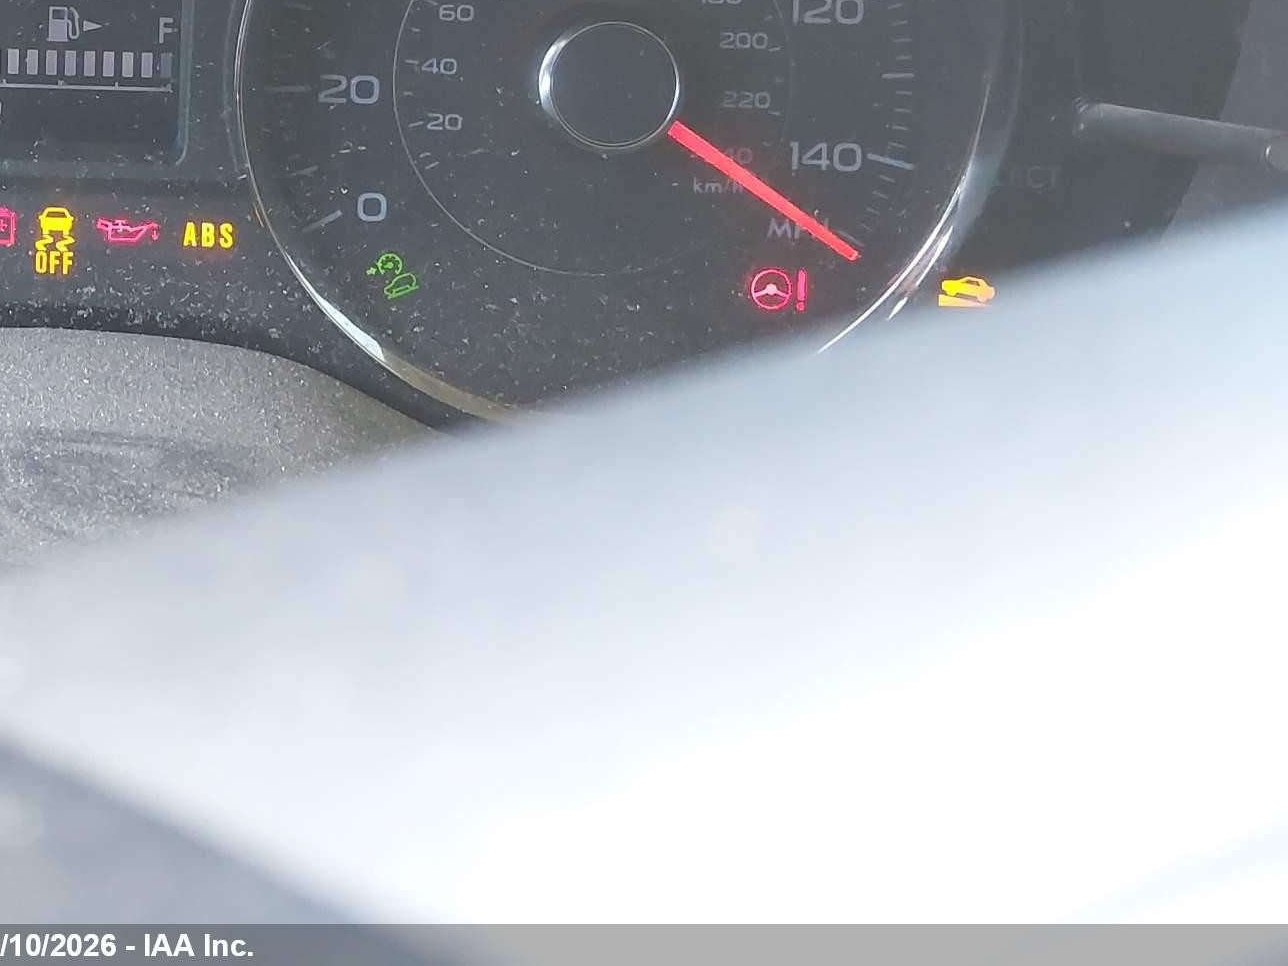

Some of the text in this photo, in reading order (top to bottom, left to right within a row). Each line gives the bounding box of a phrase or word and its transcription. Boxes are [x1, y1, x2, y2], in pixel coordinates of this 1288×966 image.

[438, 4, 475, 22] 60
[158, 16, 174, 44] F
[719, 32, 769, 50] 200
[420, 57, 458, 76] 40
[318, 74, 380, 105] 20
[722, 91, 771, 109] 220
[426, 113, 463, 131] 20
[790, 141, 863, 172] 140
[692, 177, 745, 194] km/h
[356, 192, 388, 222] 0
[183, 221, 234, 249] ABS
[35, 250, 74, 275] OFF
